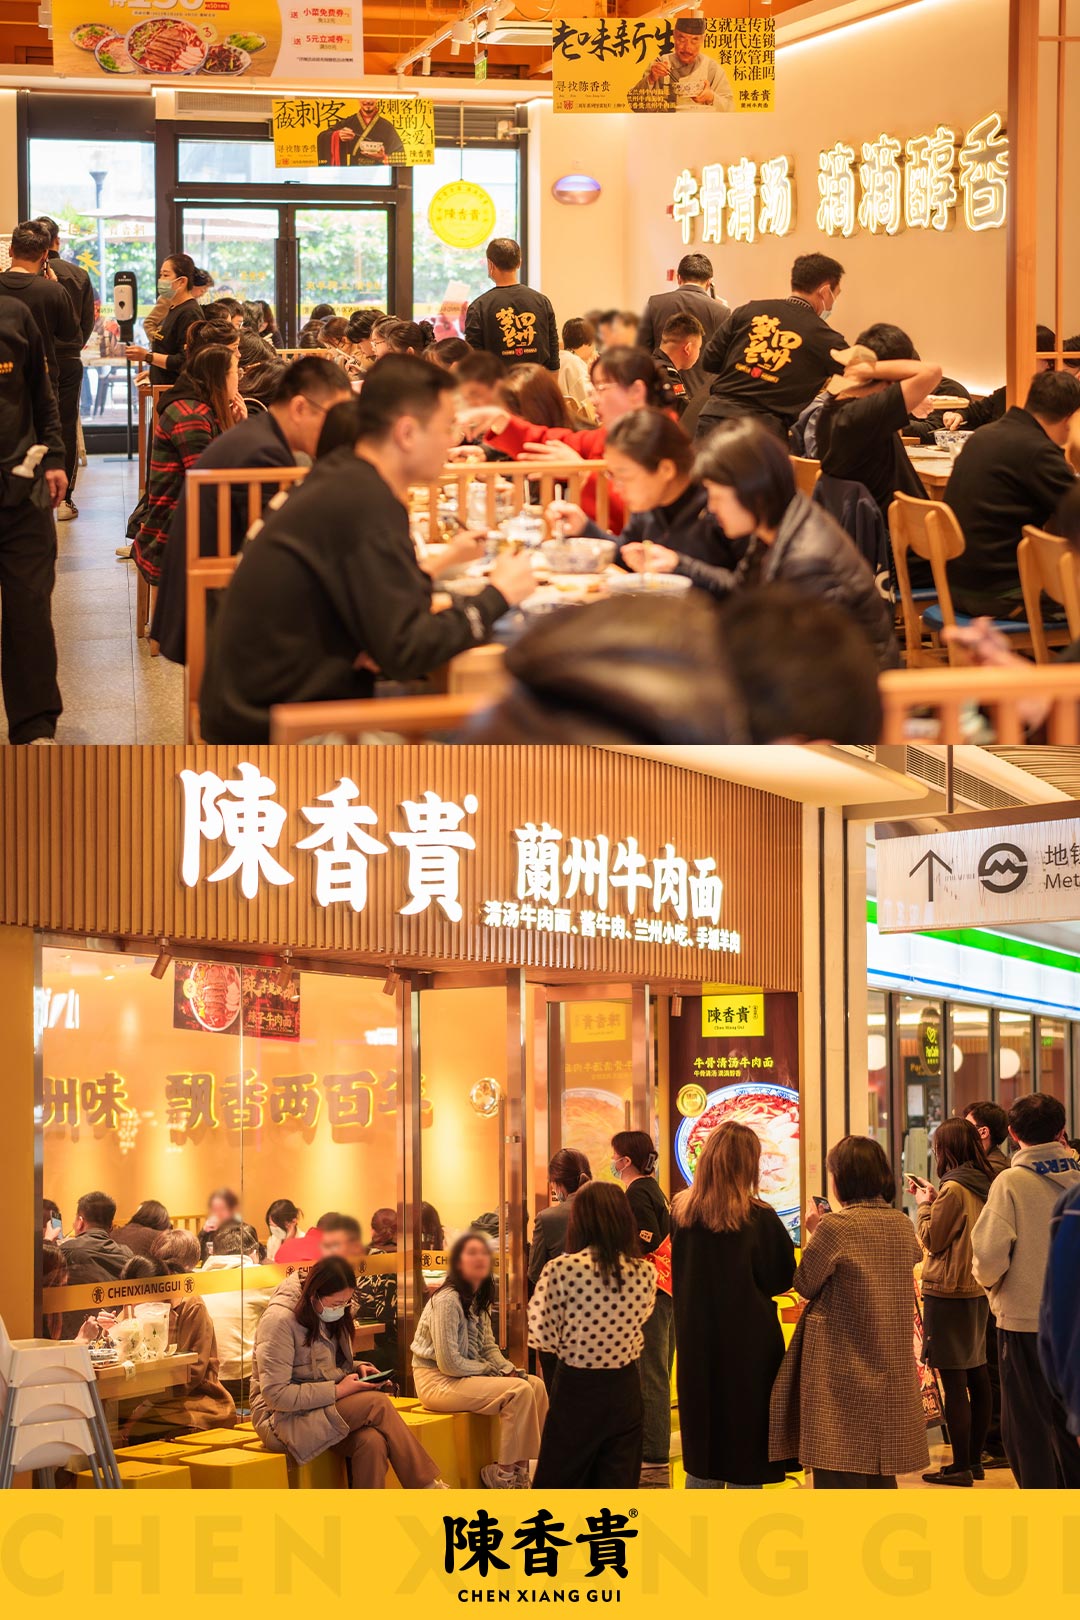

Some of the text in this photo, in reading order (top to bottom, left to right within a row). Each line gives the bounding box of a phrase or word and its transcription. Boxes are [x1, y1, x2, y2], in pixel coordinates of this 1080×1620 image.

[704, 18, 776, 33] 这就是传说
[703, 33, 776, 49] 的现代连锁
[719, 50, 776, 65] 餐饮管理
[733, 66, 776, 81] 标准吗
[391, 115, 431, 129] 过的人
[673, 112, 1009, 244] 牛骨清汤 滴滴醇香
[176, 761, 478, 923] 陳香貴
[514, 821, 723, 926] 蘭州牛肉面
[707, 1006, 750, 1024] 陳香貴
[693, 1056, 774, 1069] 牛骨清汤牛肉面
[107, 1280, 181, 1299] CHENXIANGGUI
